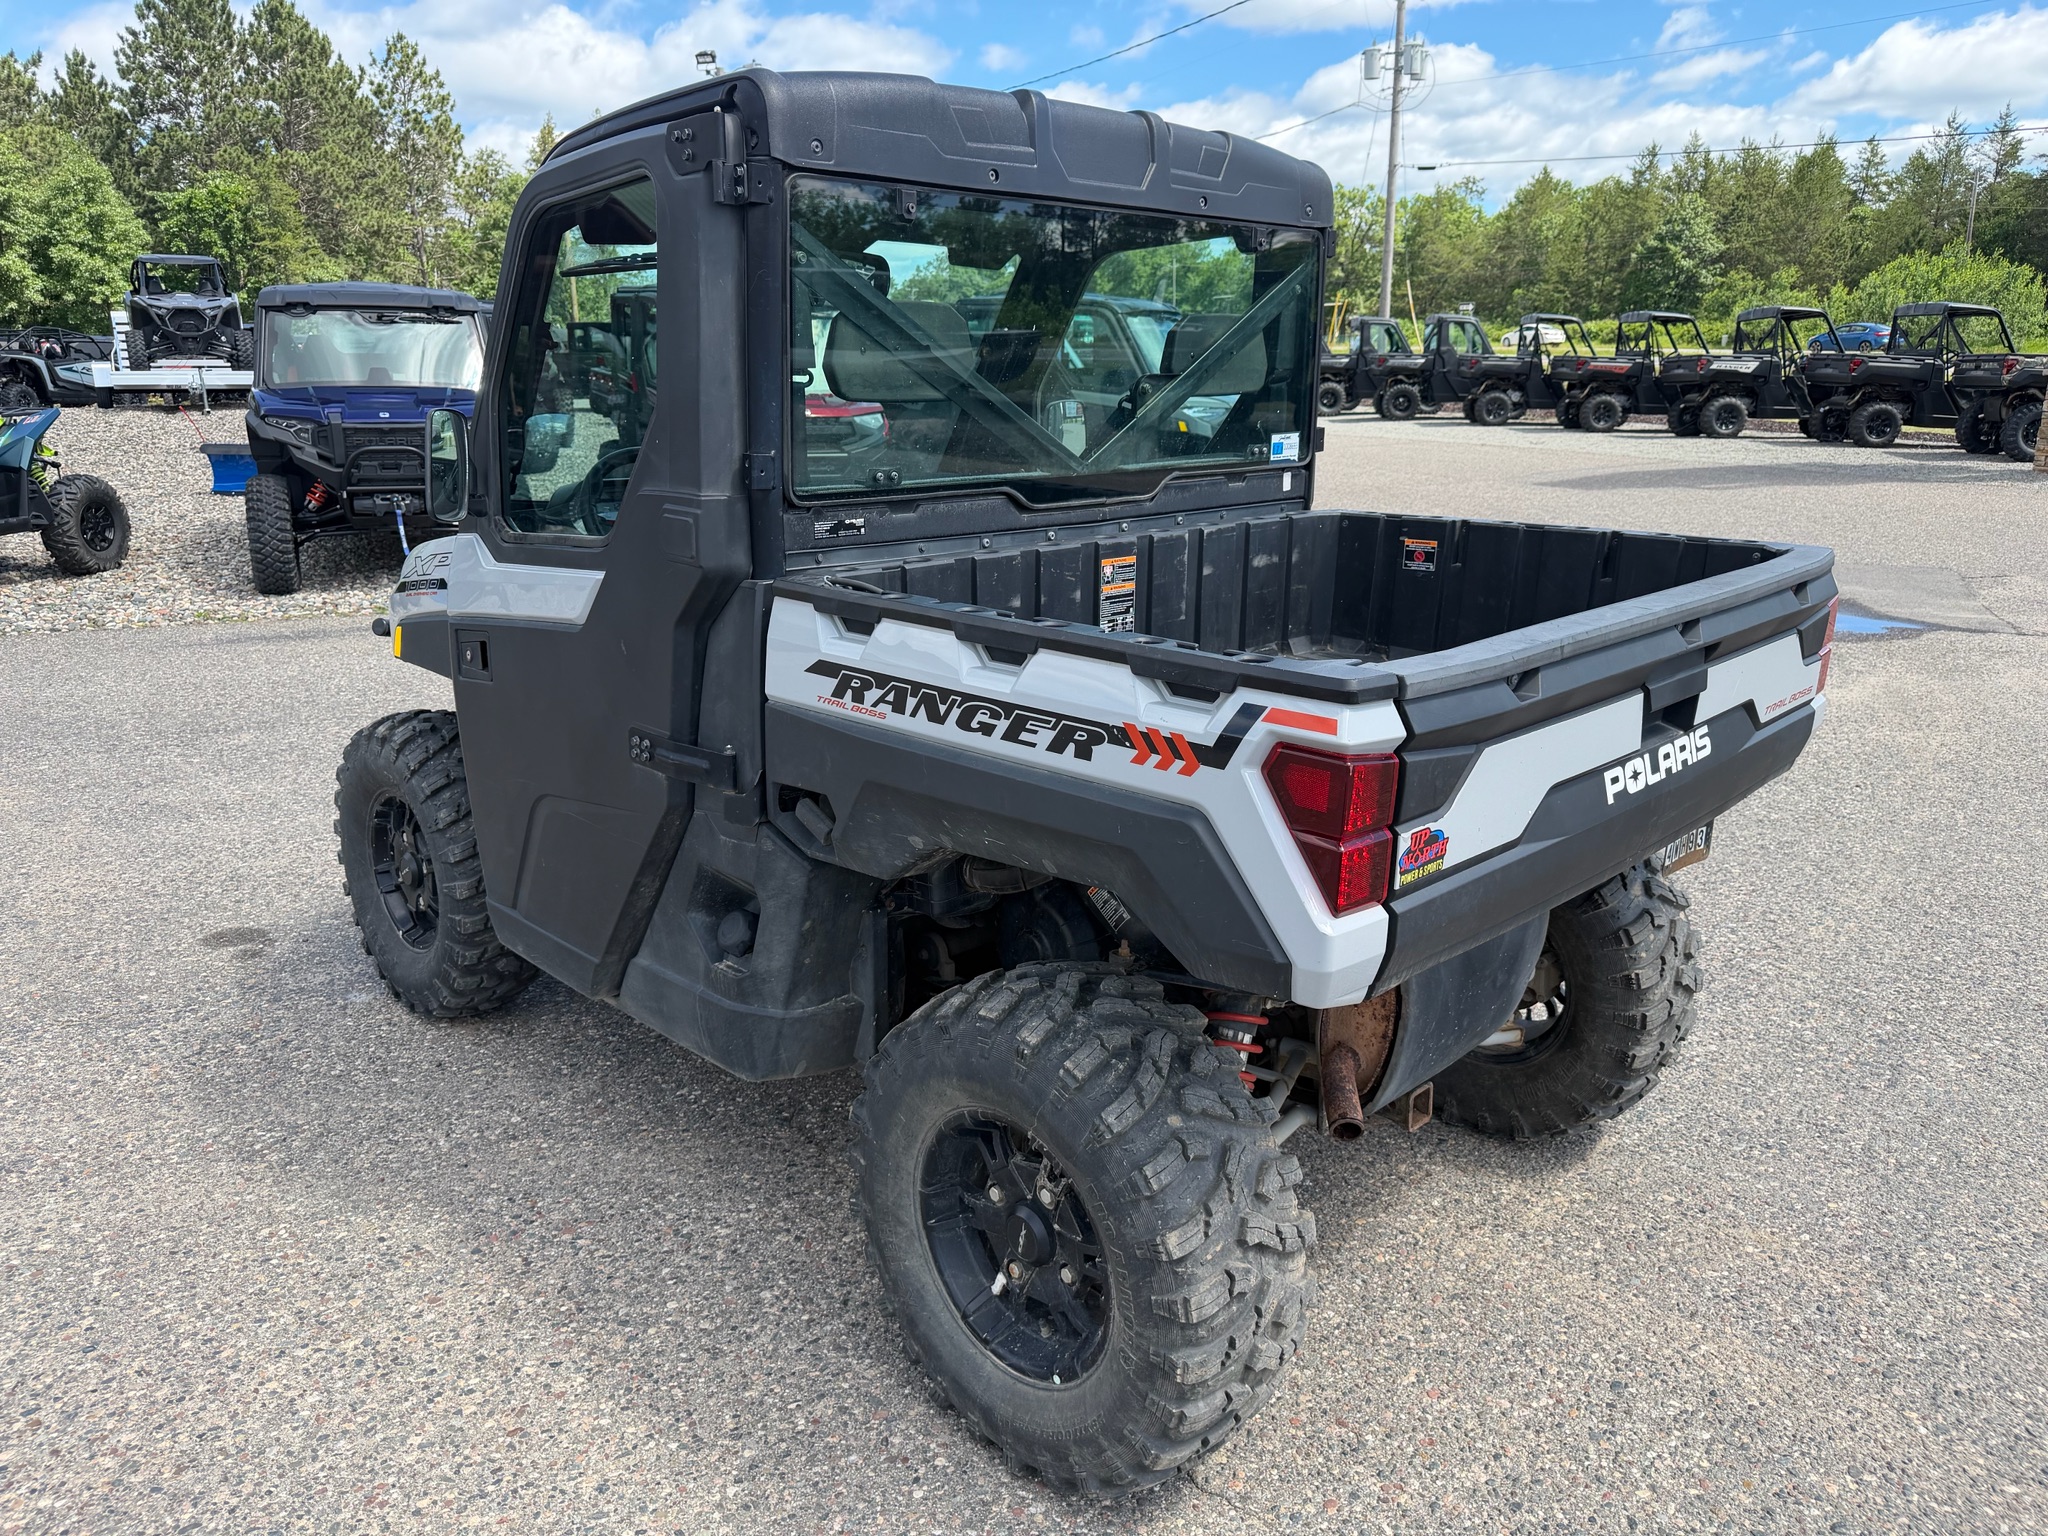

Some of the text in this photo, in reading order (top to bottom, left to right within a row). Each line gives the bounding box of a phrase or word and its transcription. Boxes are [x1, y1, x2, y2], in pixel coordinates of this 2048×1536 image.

[353, 436, 422, 447] POLARIS
[402, 551, 453, 579] XP
[817, 695, 888, 720] TRAIL BOSS
[1765, 685, 1813, 715] TRAIL BOSS
[830, 670, 1108, 762] RANGER
[1604, 725, 1711, 805] POLARIS
[1410, 828, 1431, 851] UP
[1401, 838, 1449, 872] NORTH
[1400, 868, 1418, 887] POWER
[1423, 859, 1443, 877] SPORTS
